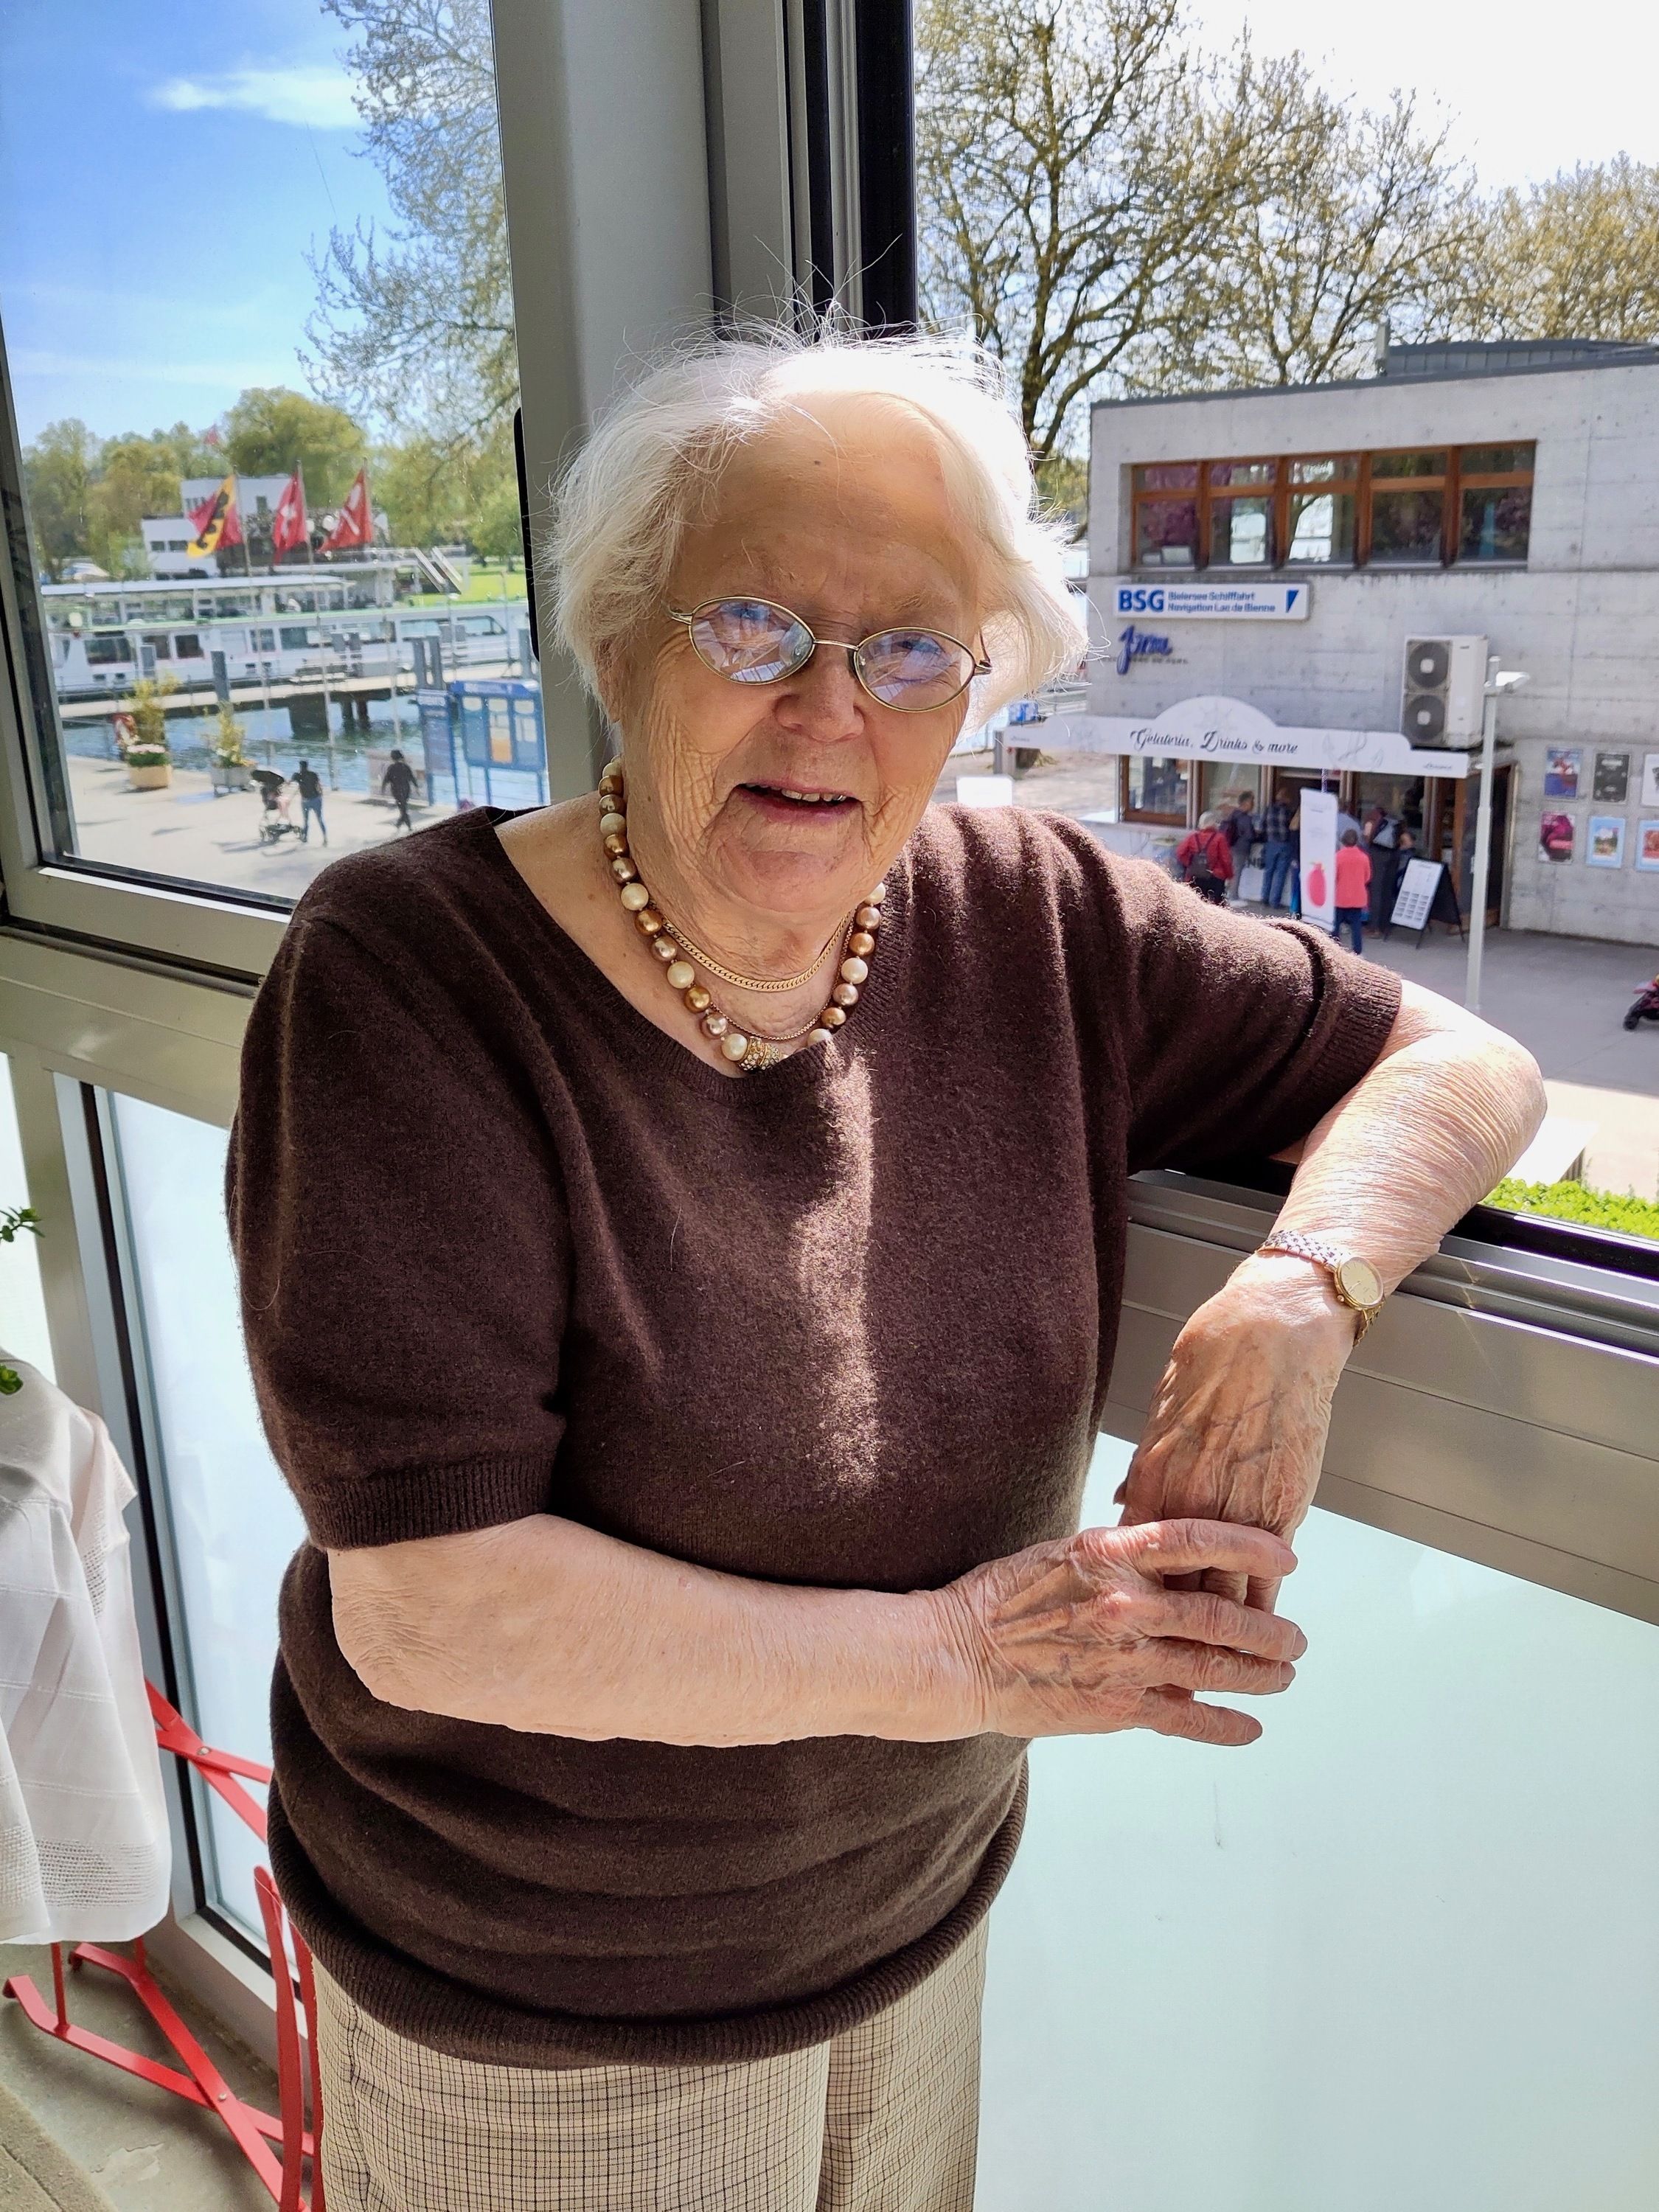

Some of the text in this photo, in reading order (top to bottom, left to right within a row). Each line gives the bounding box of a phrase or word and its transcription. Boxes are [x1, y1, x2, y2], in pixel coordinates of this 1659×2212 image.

[1119, 589, 1164, 612] BSG
[1168, 603, 1276, 613] Navigation Lac de Bienne
[1200, 731, 1248, 752] Drinks
[1253, 740, 1264, 754] &
[1267, 743, 1298, 754] more
